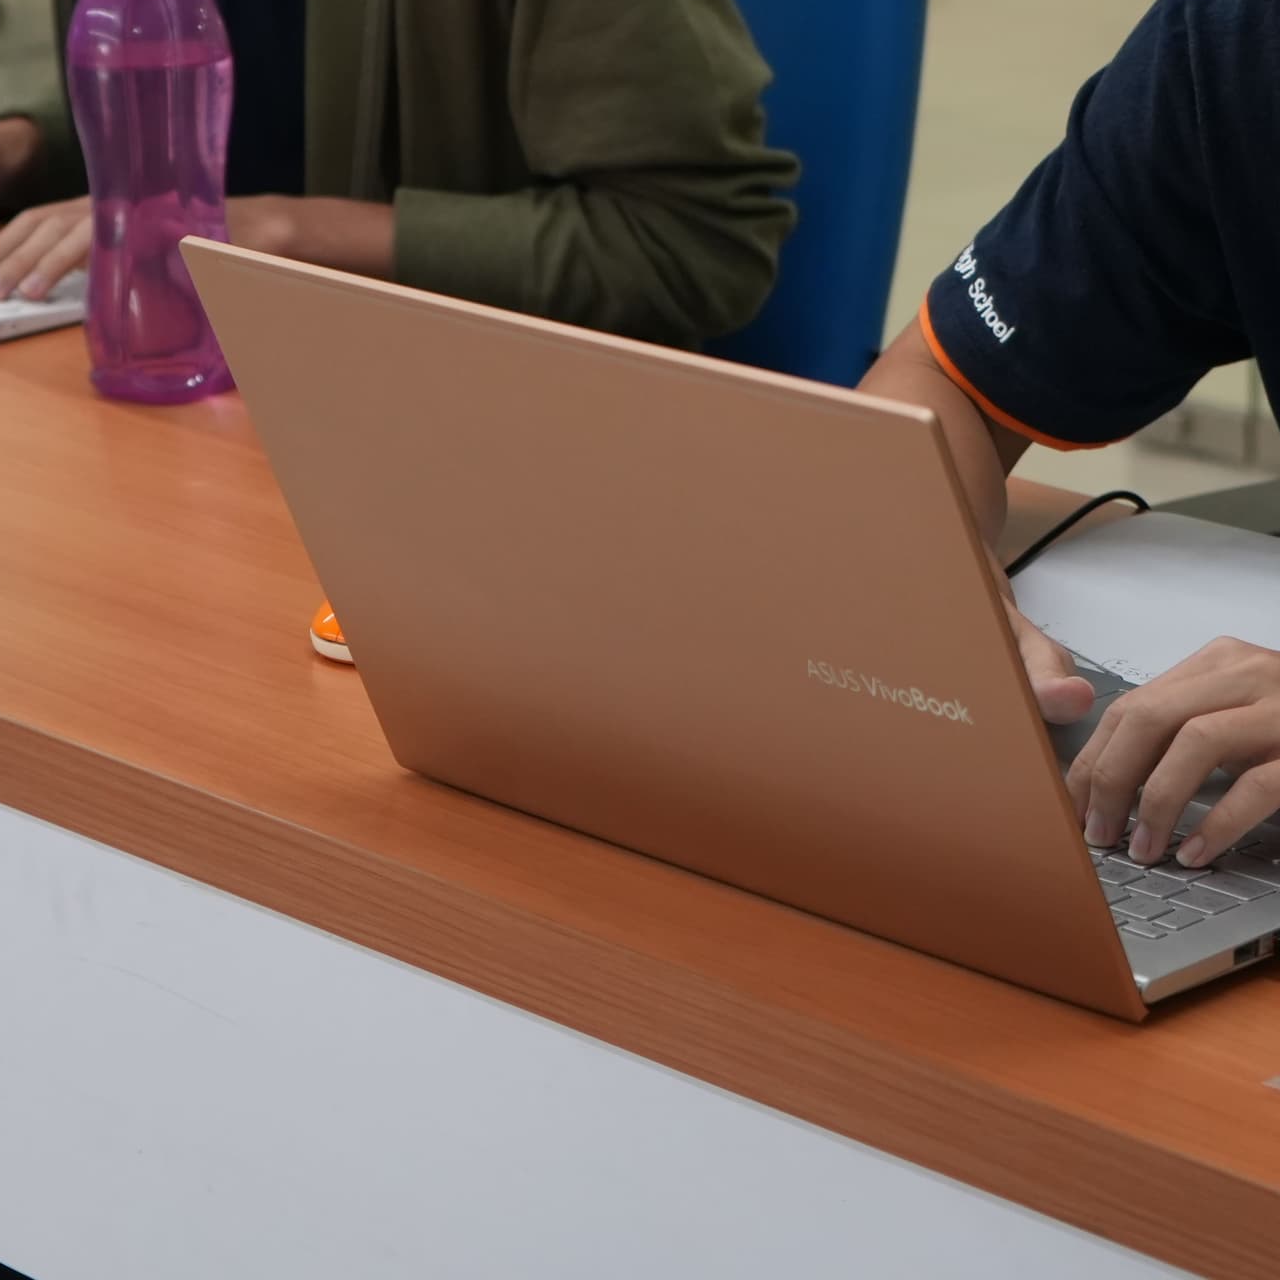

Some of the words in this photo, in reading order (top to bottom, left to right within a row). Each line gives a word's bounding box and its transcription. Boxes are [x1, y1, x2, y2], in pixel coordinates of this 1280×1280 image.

[968, 277, 1016, 343] School
[807, 658, 861, 693] ASUS
[859, 672, 974, 726] VivoBook
